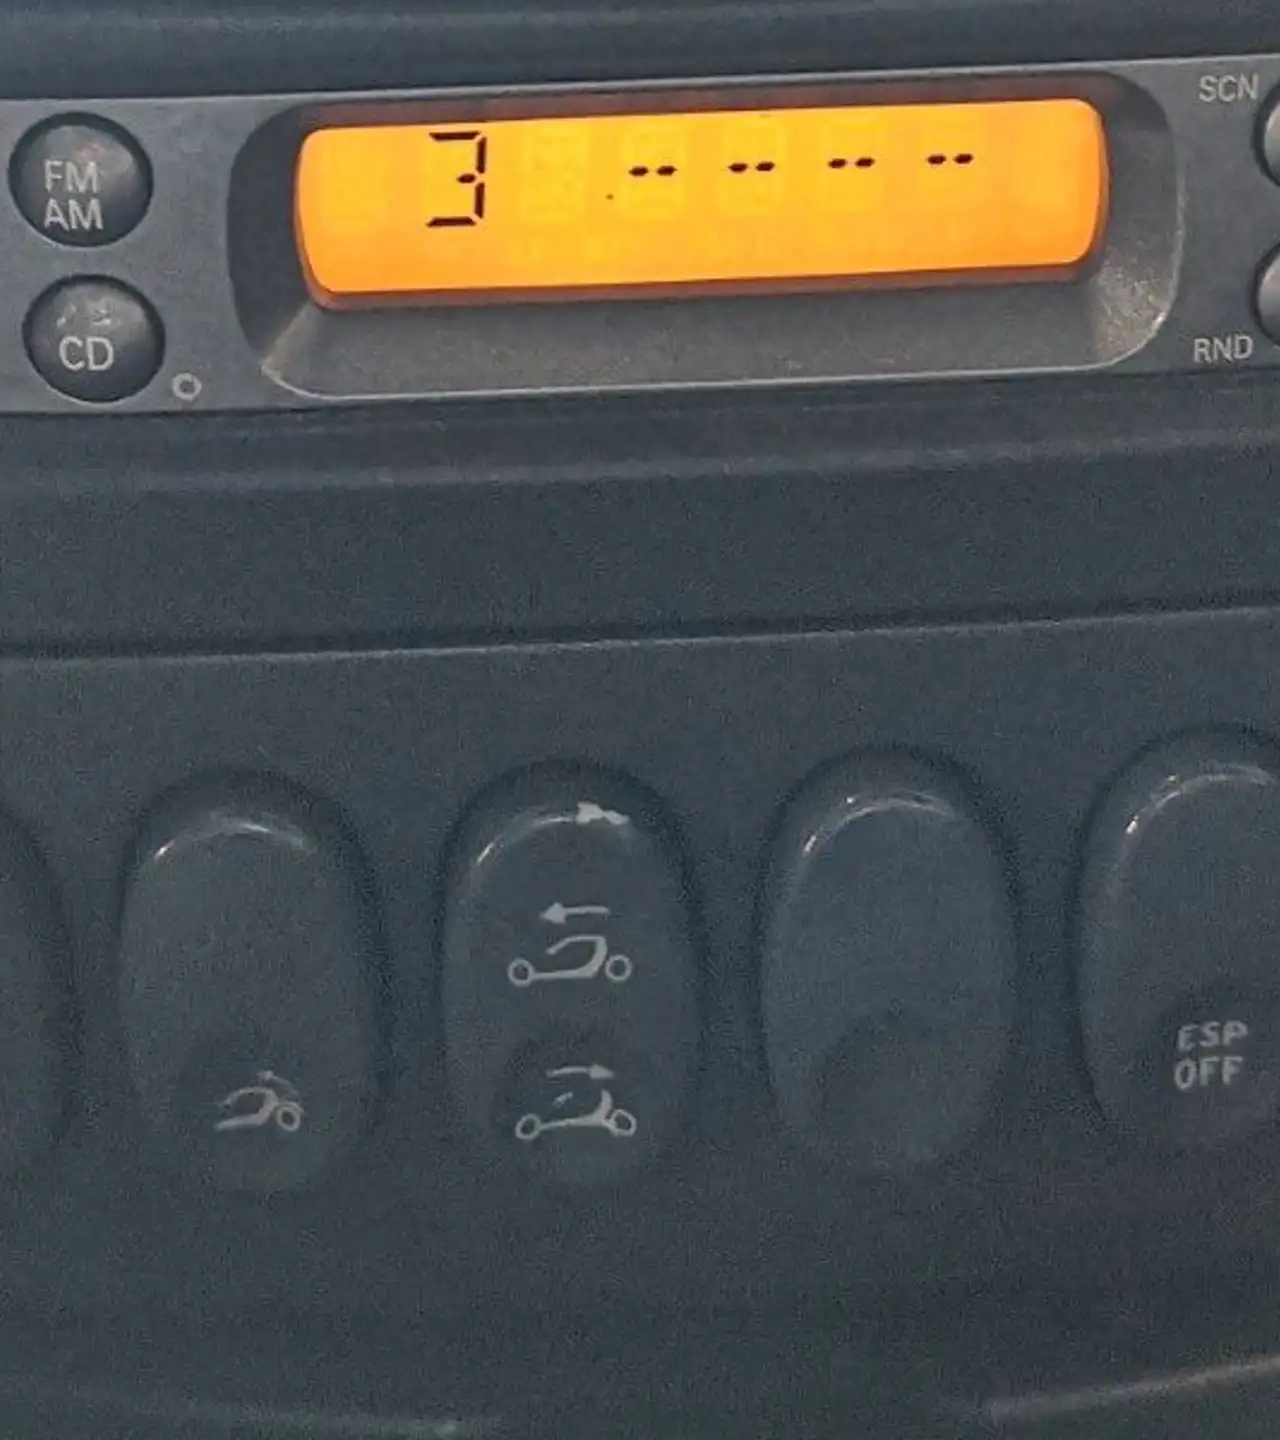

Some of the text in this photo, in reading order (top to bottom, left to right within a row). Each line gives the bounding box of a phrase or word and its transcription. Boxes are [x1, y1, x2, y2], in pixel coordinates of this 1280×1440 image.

[1198, 76, 1259, 103] SCN
[44, 159, 100, 194] FM
[43, 198, 103, 231] AM
[58, 335, 115, 372] CD
[1193, 335, 1254, 364] RND
[1177, 1020, 1249, 1052] ESP
[1174, 1055, 1244, 1091] OFF
